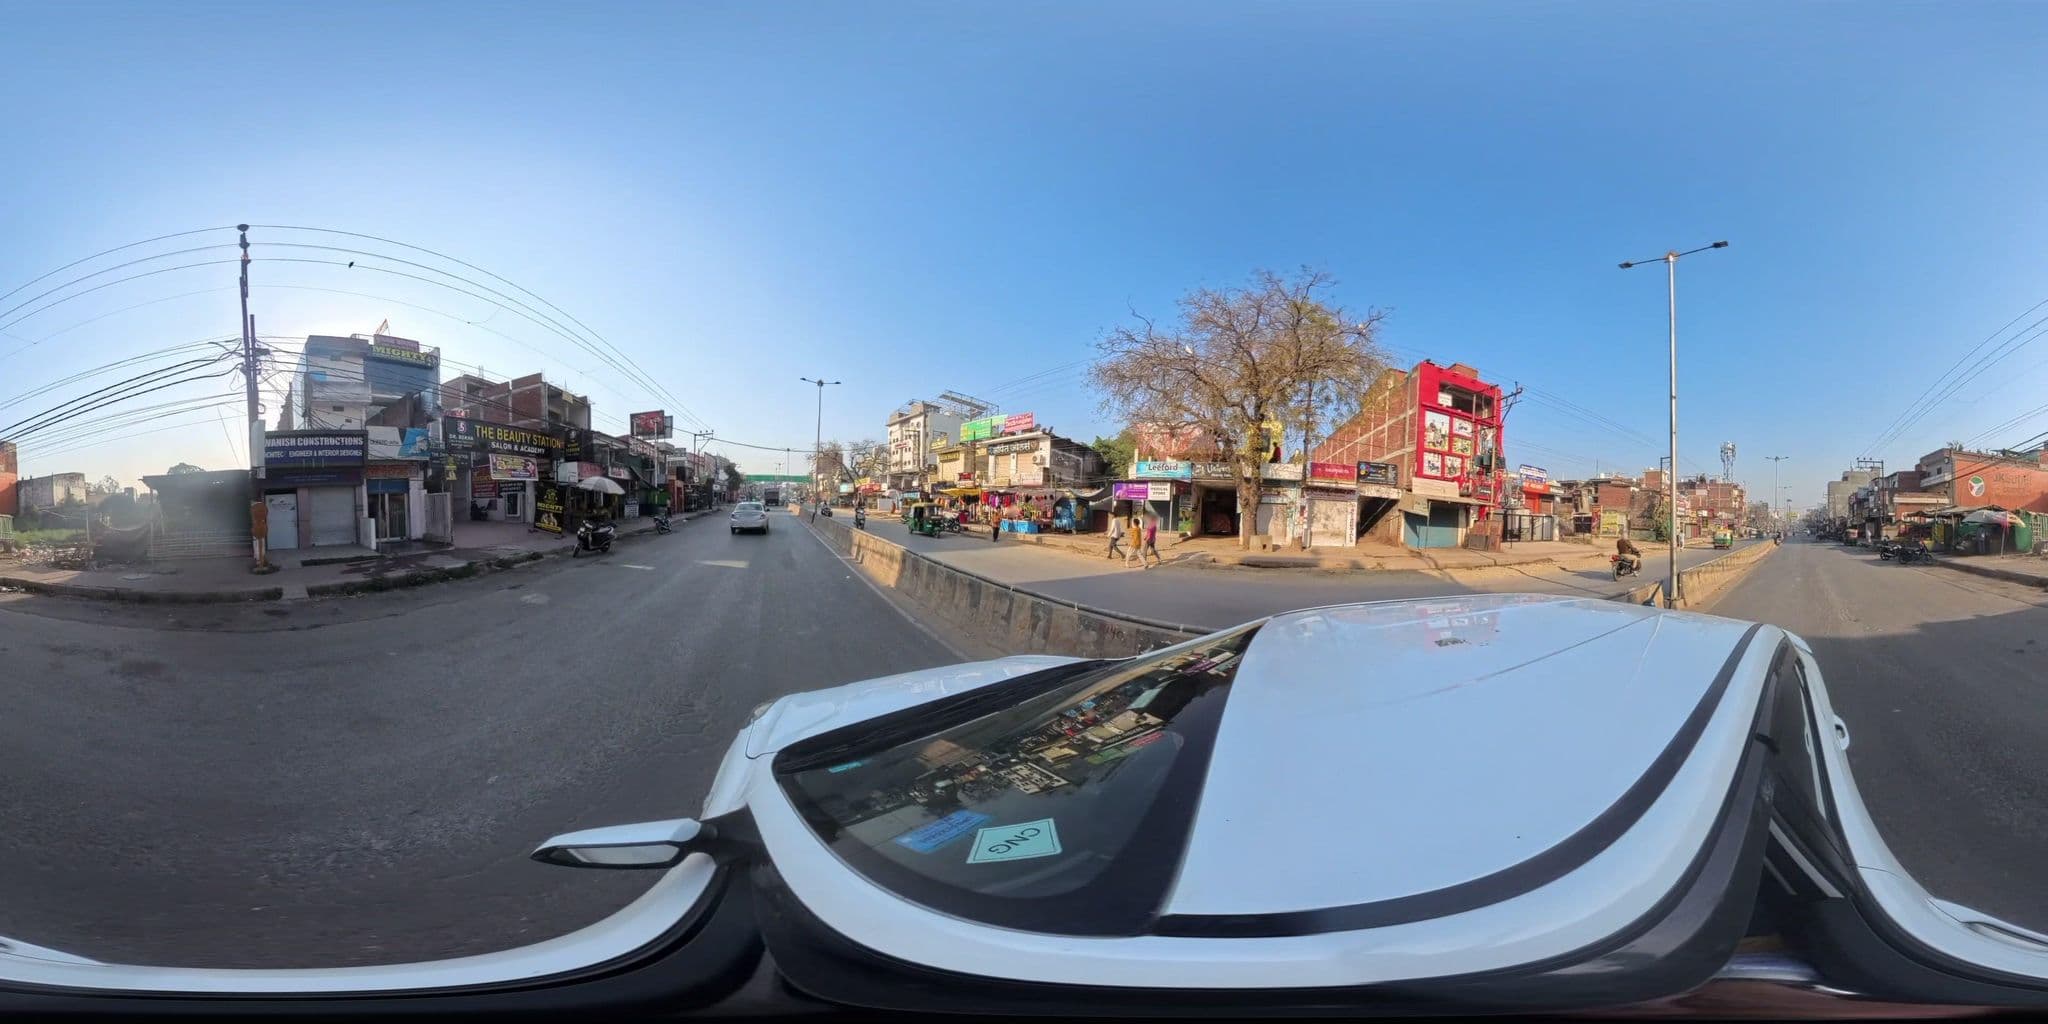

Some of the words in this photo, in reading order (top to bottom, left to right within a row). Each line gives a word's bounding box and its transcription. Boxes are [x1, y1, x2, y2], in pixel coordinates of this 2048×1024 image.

[373, 345, 427, 361] MIGHTY
[297, 437, 364, 446] CONSTRUCTIONS
[474, 424, 494, 440] THE
[496, 427, 531, 444] BEAUTY
[532, 434, 561, 448] STATION
[491, 441, 512, 450] SALON
[520, 445, 545, 454] ACADEMY
[1148, 463, 1178, 471] Leeford
[988, 827, 1041, 854] CNG
